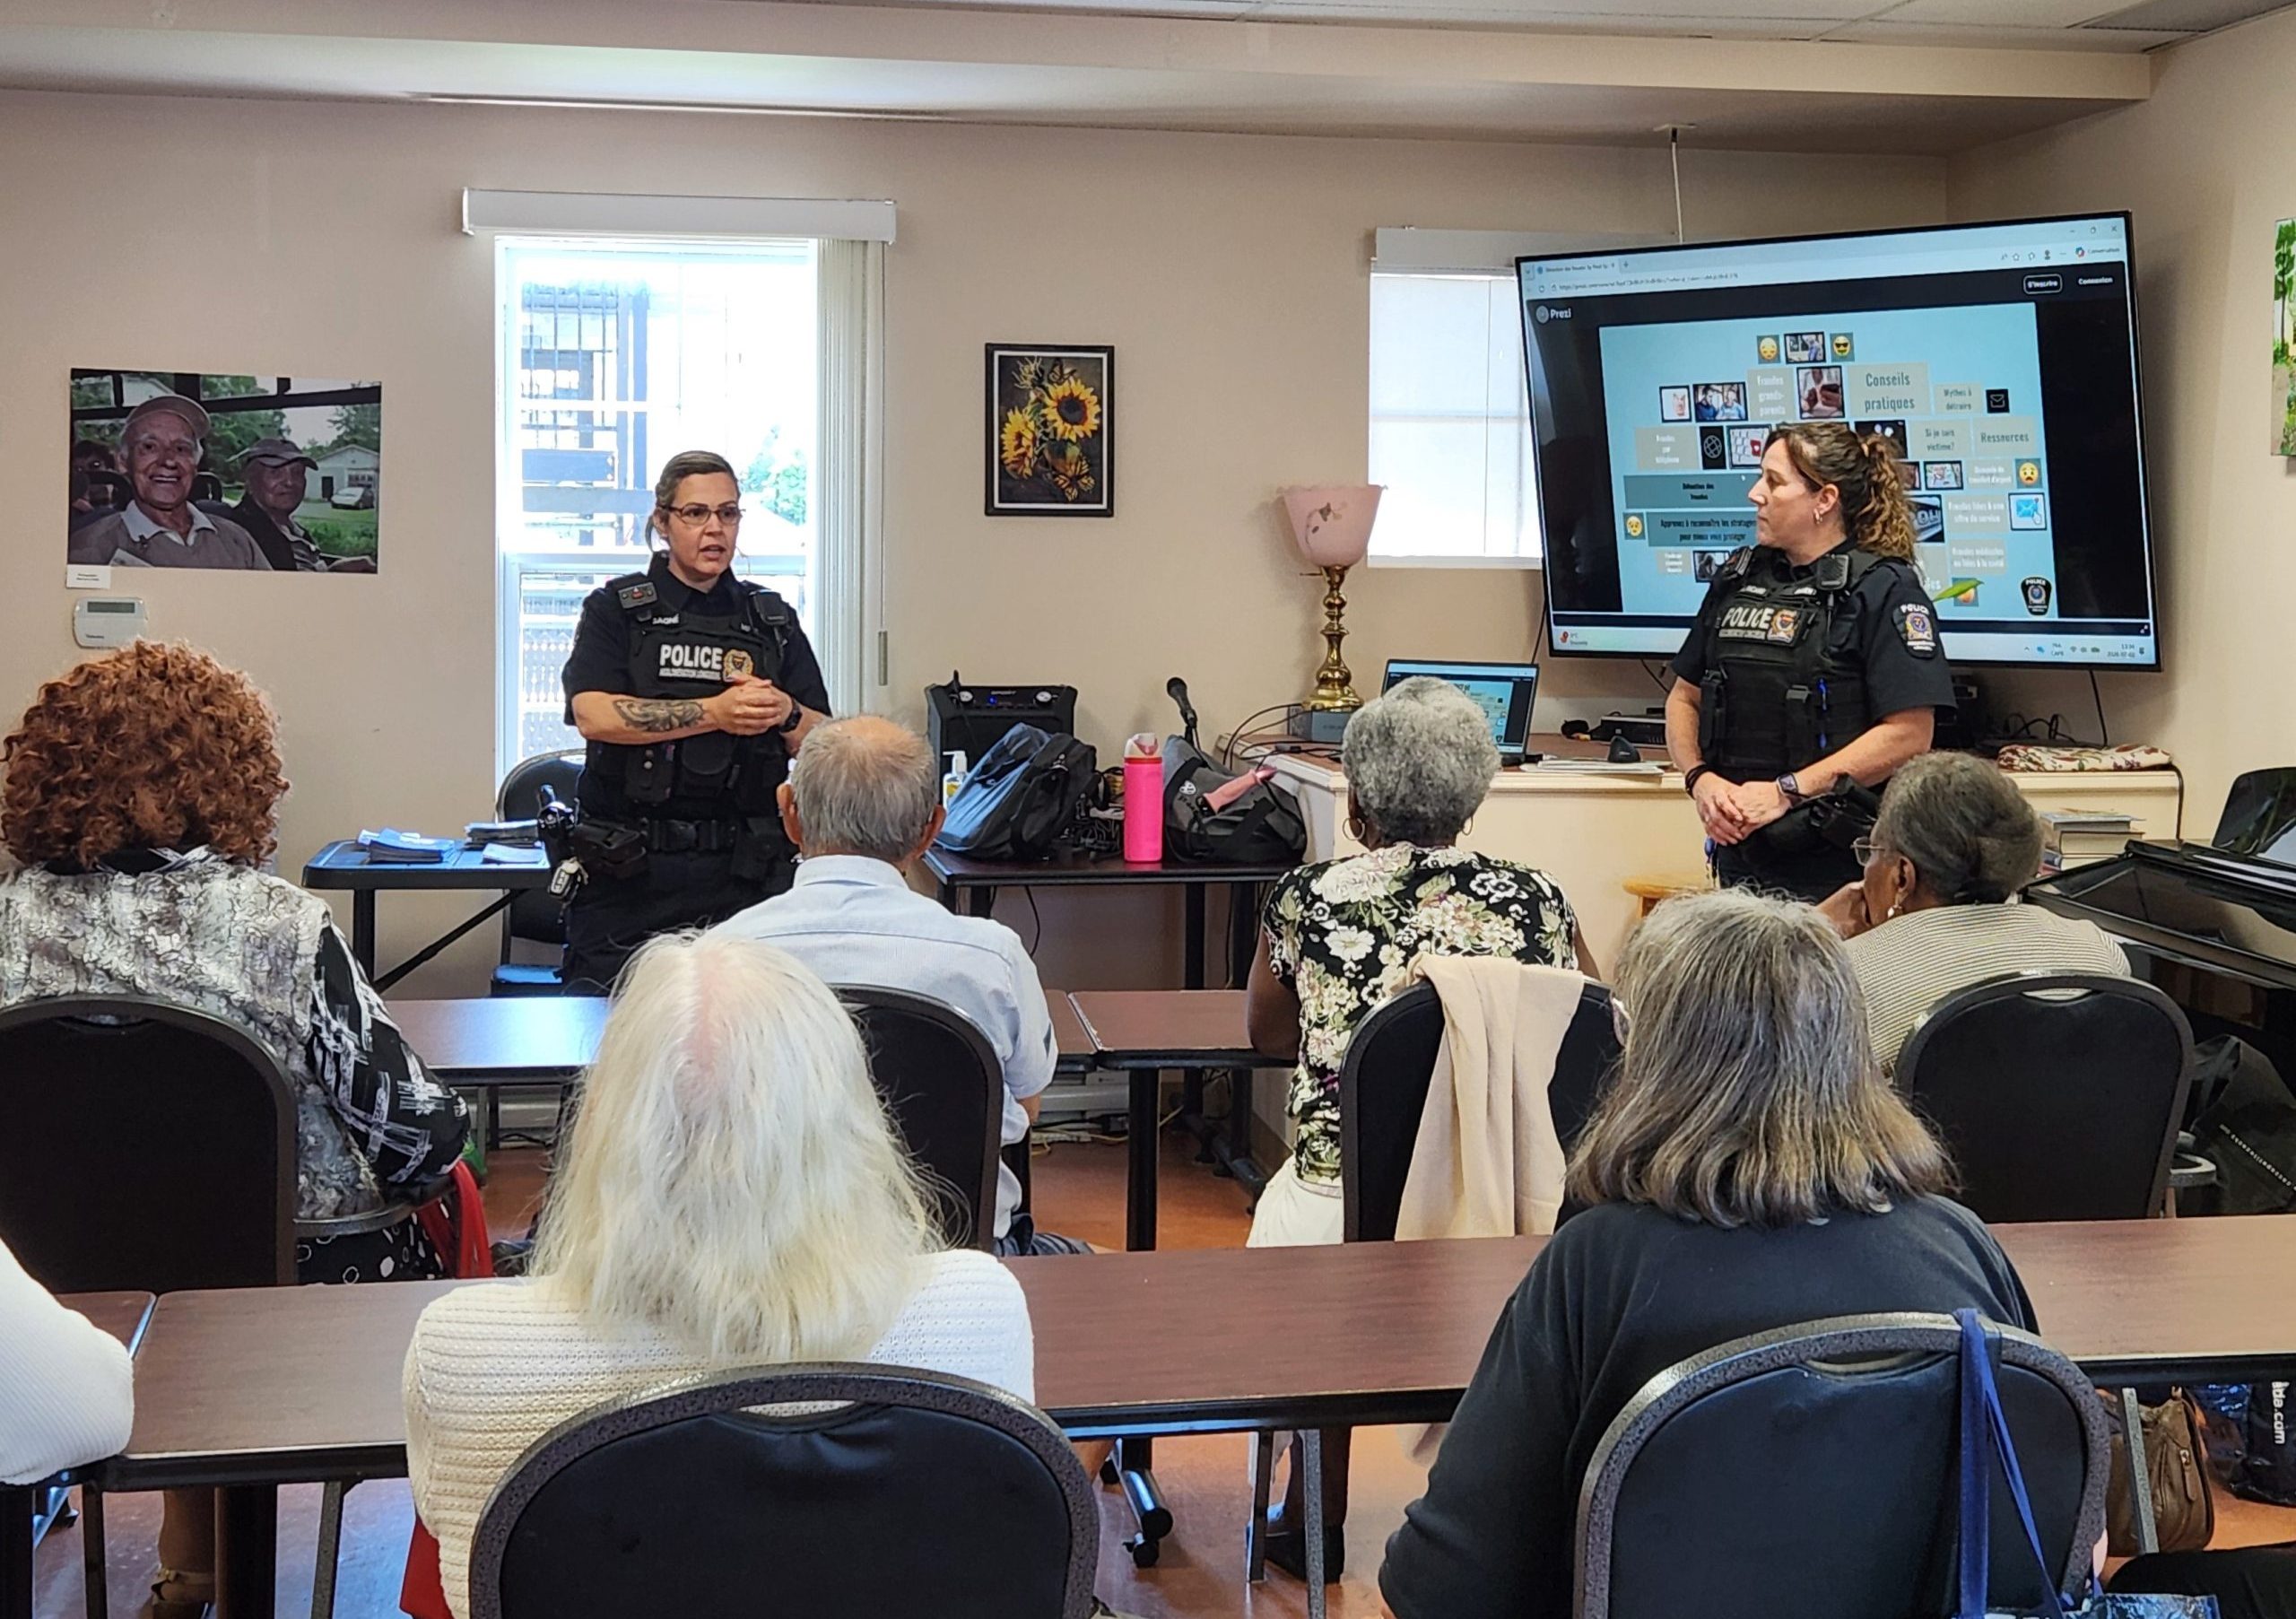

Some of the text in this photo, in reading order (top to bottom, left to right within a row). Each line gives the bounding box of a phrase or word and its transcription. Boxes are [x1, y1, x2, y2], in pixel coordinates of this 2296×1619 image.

[1550, 308, 1571, 319] Prezi
[1866, 372, 1910, 387] Conseils
[1865, 397, 1915, 413] pratiques
[1980, 432, 2030, 443] Ressources
[1720, 605, 1775, 630] POLICE
[659, 644, 723, 669] POLICE
